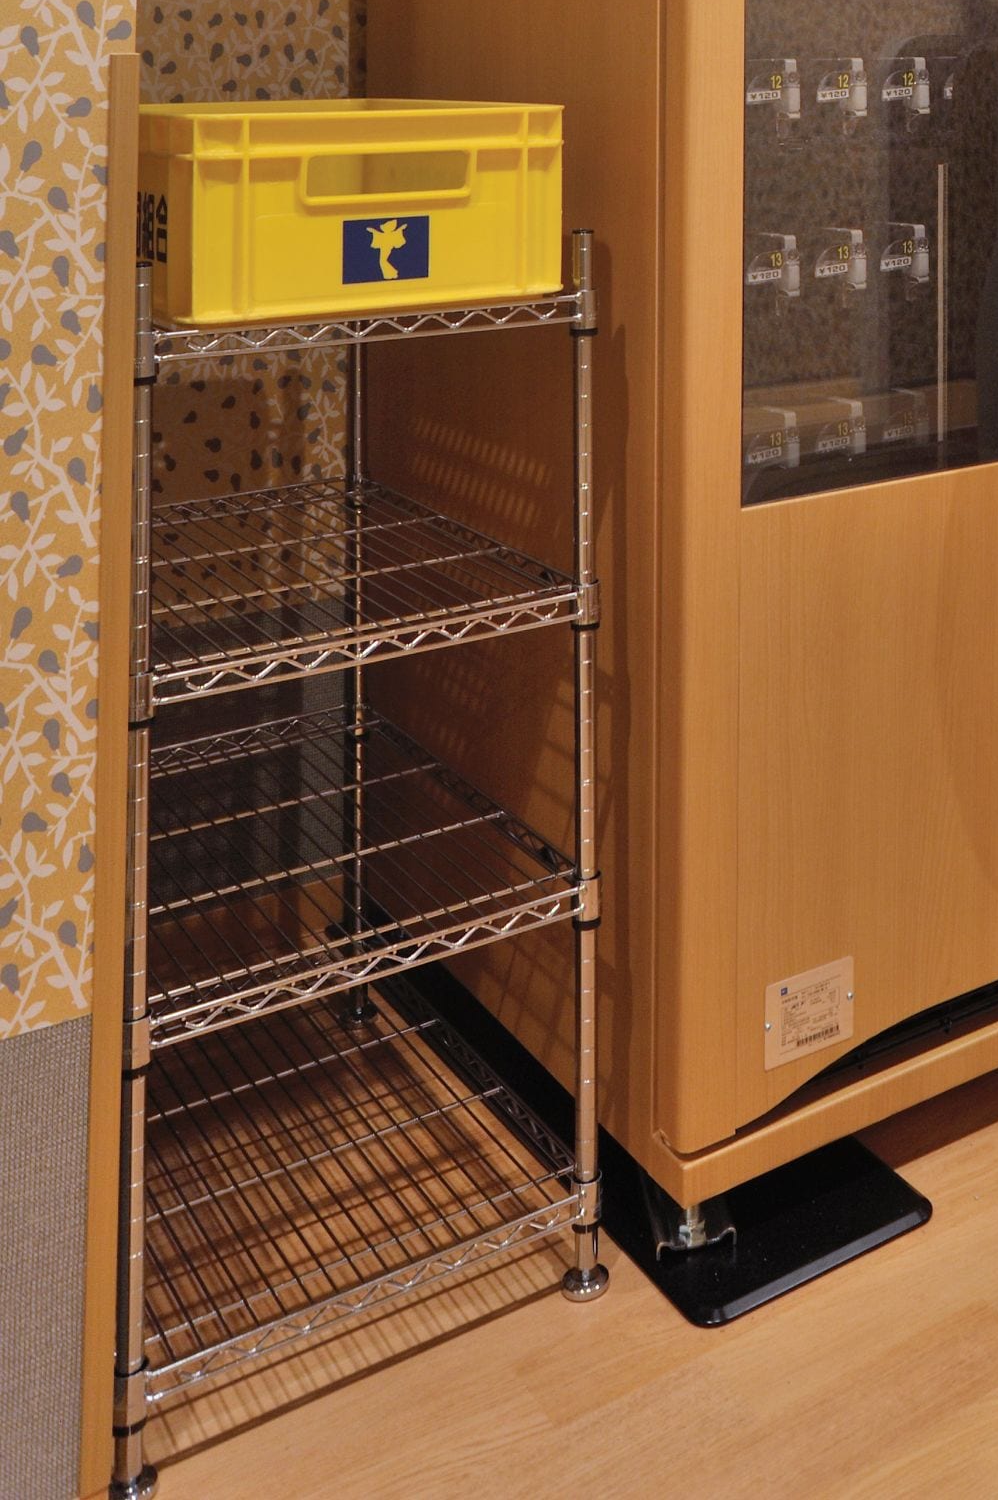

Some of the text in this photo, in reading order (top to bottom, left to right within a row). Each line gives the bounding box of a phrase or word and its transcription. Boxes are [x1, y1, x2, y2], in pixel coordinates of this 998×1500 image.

[770, 75, 782, 89] 12
[838, 74, 849, 88] 12
[903, 73, 914, 86] 12
[751, 92, 779, 100] ¥120
[821, 91, 847, 99] ¥120
[886, 88, 911, 97] ¥120
[838, 246, 849, 260] 13
[903, 240, 913, 254] 13
[770, 252, 783, 267] 13
[884, 257, 910, 267] ¥120
[751, 270, 779, 280] ¥120
[818, 266, 846, 275] ¥120
[838, 422, 848, 436] 13
[770, 432, 782, 446] 13
[751, 449, 779, 460] ¥120
